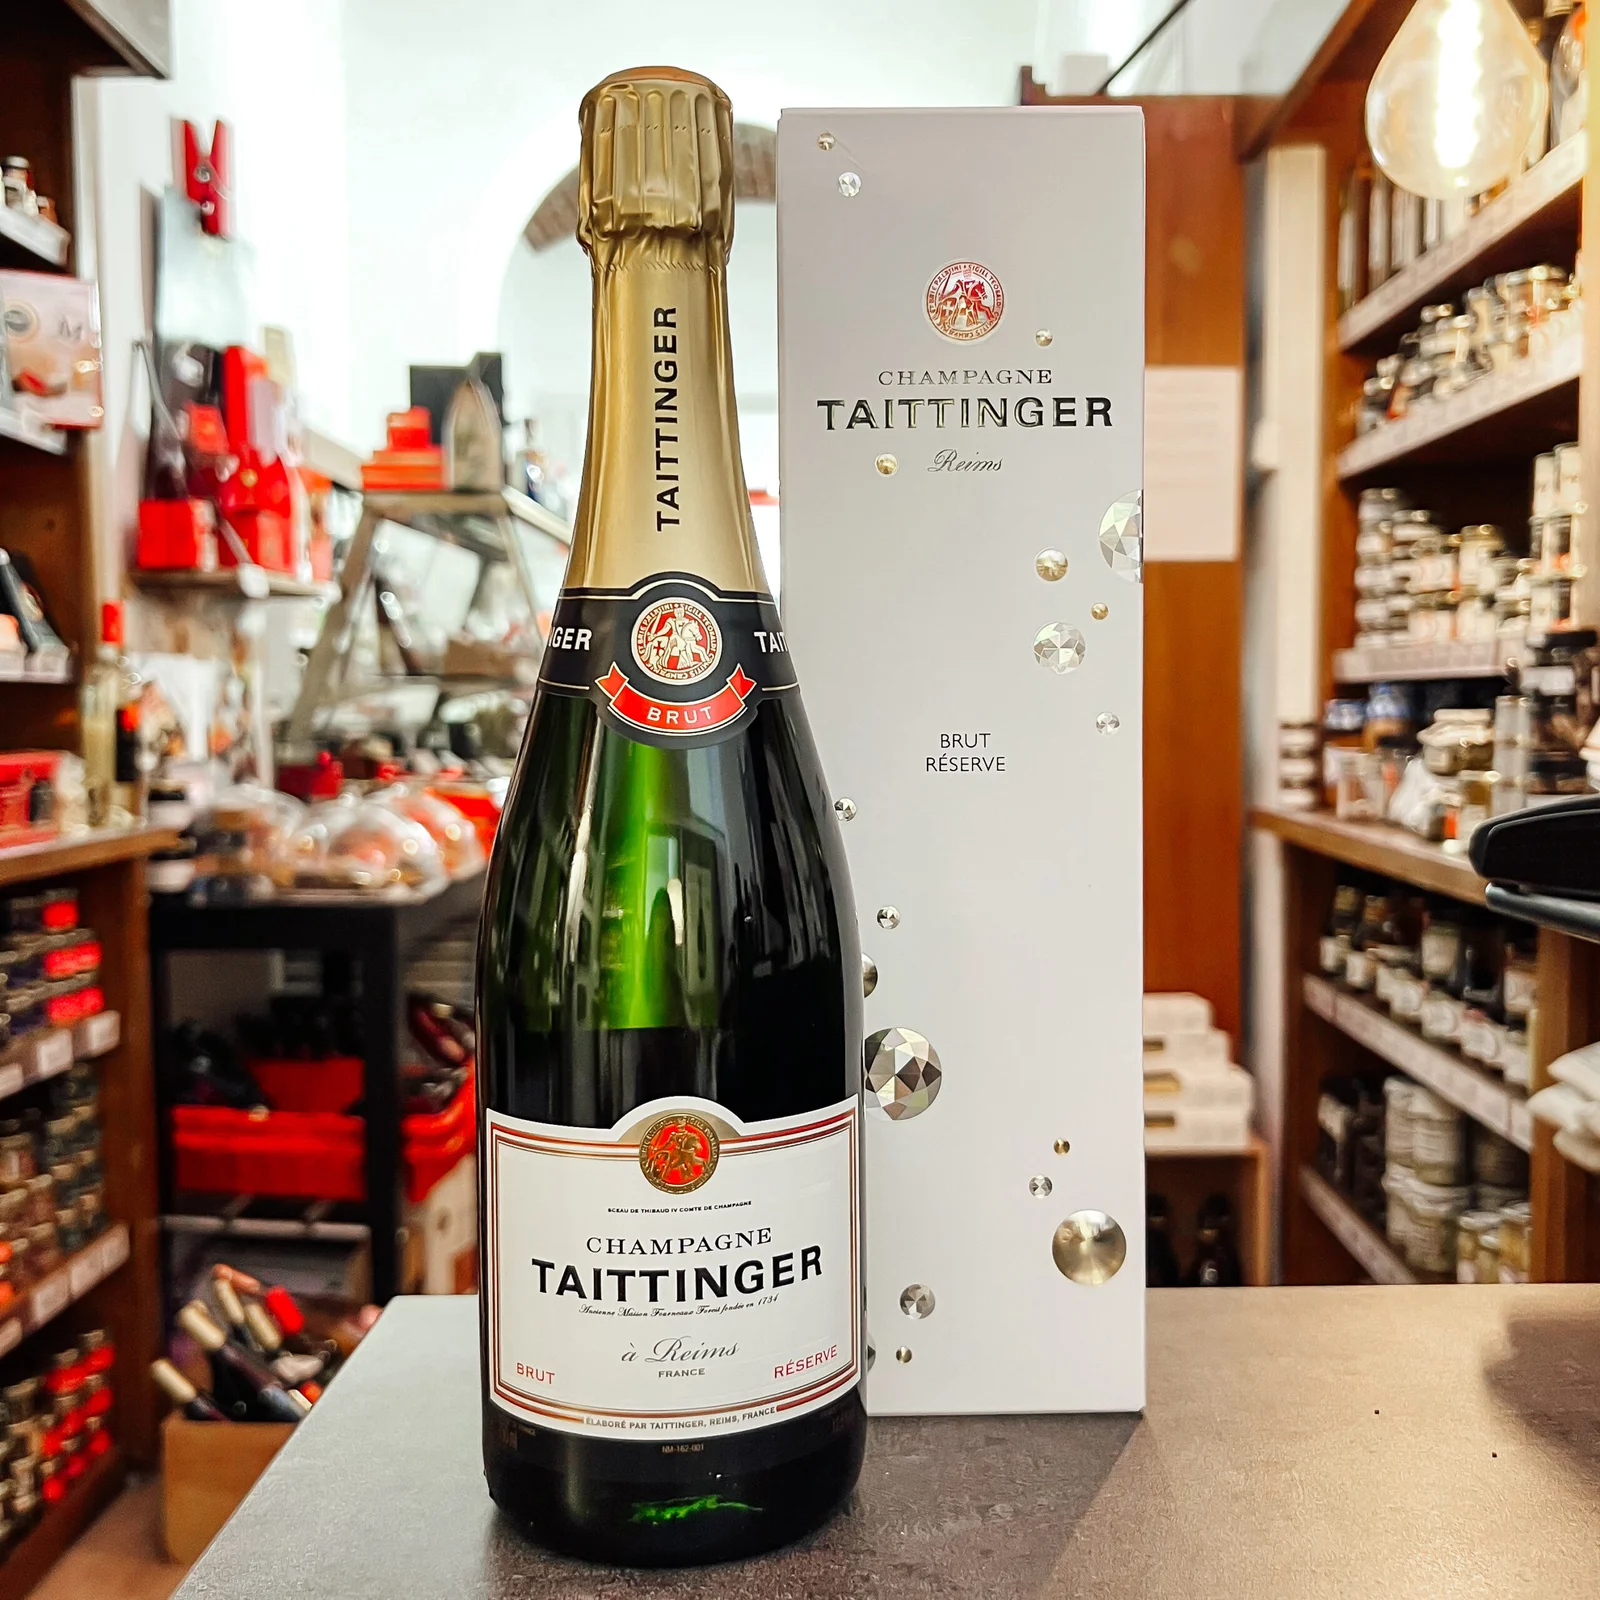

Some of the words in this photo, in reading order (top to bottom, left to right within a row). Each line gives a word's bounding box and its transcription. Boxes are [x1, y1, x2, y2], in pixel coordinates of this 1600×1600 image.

[878, 369, 1052, 386] CHAMPAGNE
[653, 307, 680, 532] TAITTINGER
[816, 396, 1114, 431] TAITTINGER
[927, 448, 1004, 474] Reims
[647, 705, 713, 724] BRUT
[940, 733, 991, 748] BRUT
[926, 753, 1006, 772] RÉSERVE
[714, 1200, 752, 1210] CHAMPAGNE
[586, 1227, 773, 1255] CHAMPAGNE
[531, 1245, 823, 1303] TAITTINGER
[757, 1292, 780, 1306] 1734
[621, 1342, 638, 1362] à
[644, 1335, 740, 1363] Reims
[658, 1367, 706, 1379] FRANCE
[774, 1344, 838, 1379] RÉSERVE
[516, 1362, 555, 1385] BRUT
[586, 1416, 627, 1429] ÉLABORÉ
[629, 1421, 647, 1430] PAR
[649, 1419, 707, 1430] TAITTINGER,
[709, 1415, 740, 1426] REIMS,
[742, 1406, 776, 1421] FRANCE
